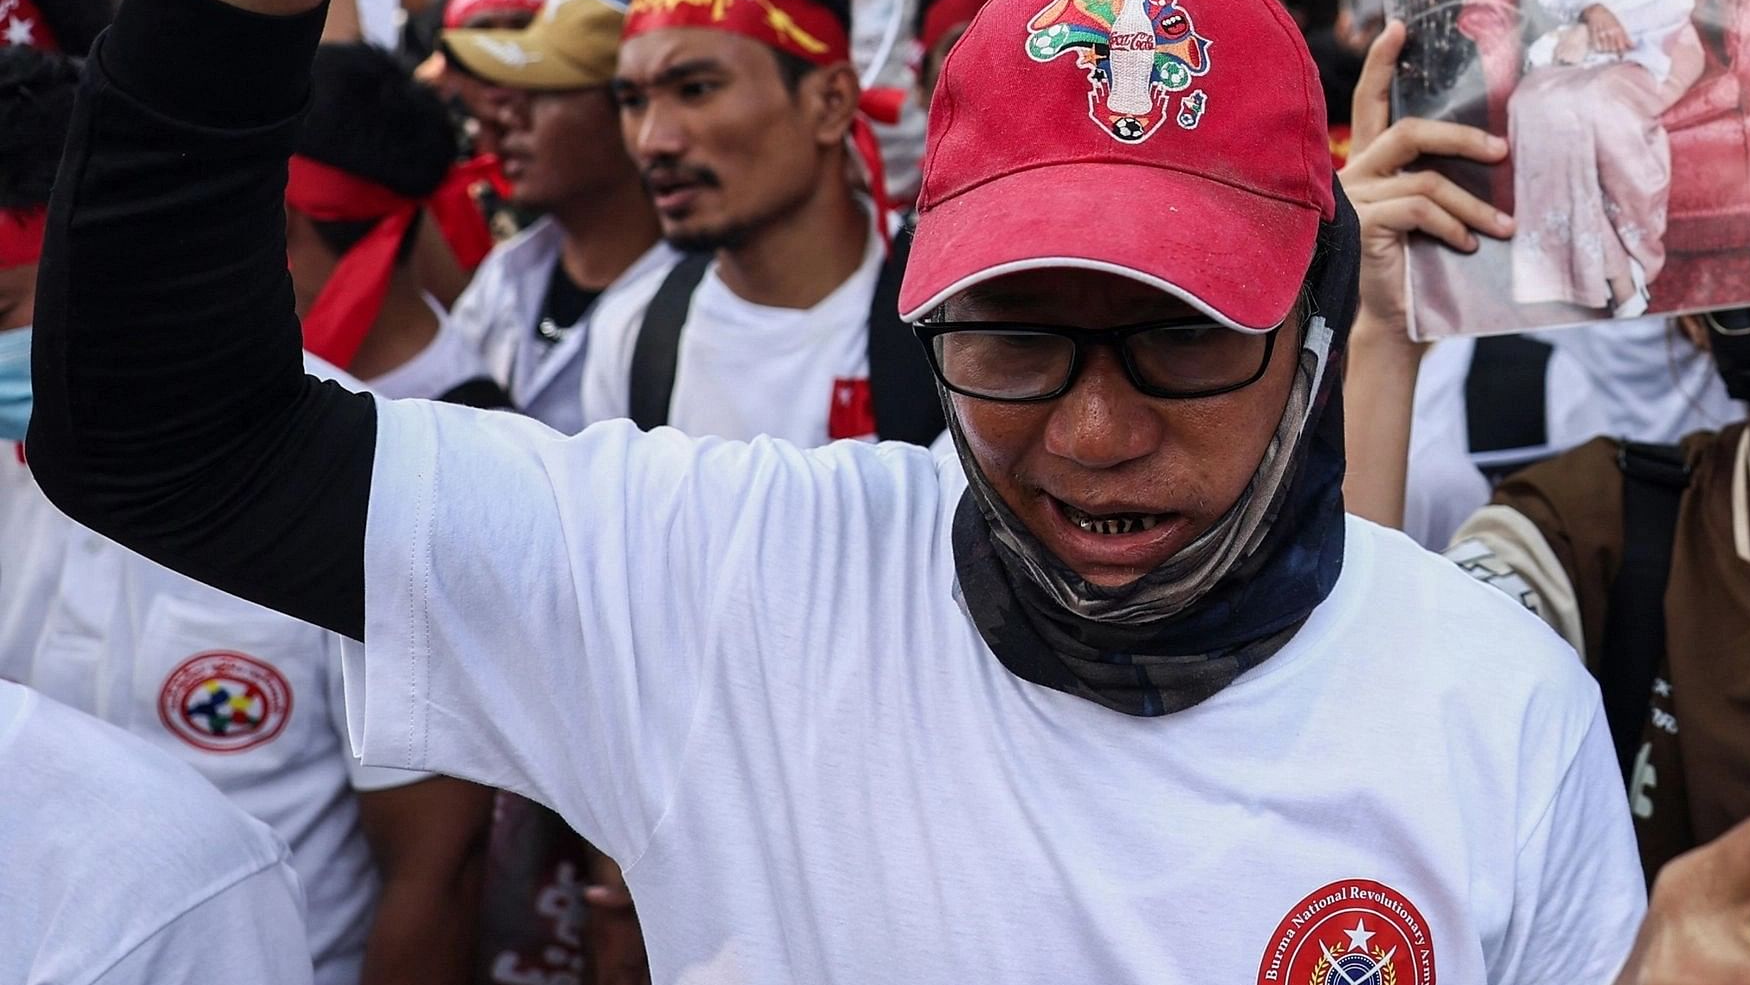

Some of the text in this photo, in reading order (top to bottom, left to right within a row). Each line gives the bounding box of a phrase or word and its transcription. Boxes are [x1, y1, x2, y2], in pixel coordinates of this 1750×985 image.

[1265, 929, 1296, 981] Burma
[1291, 887, 1347, 929] National
[1350, 886, 1426, 946] Revolutionary
